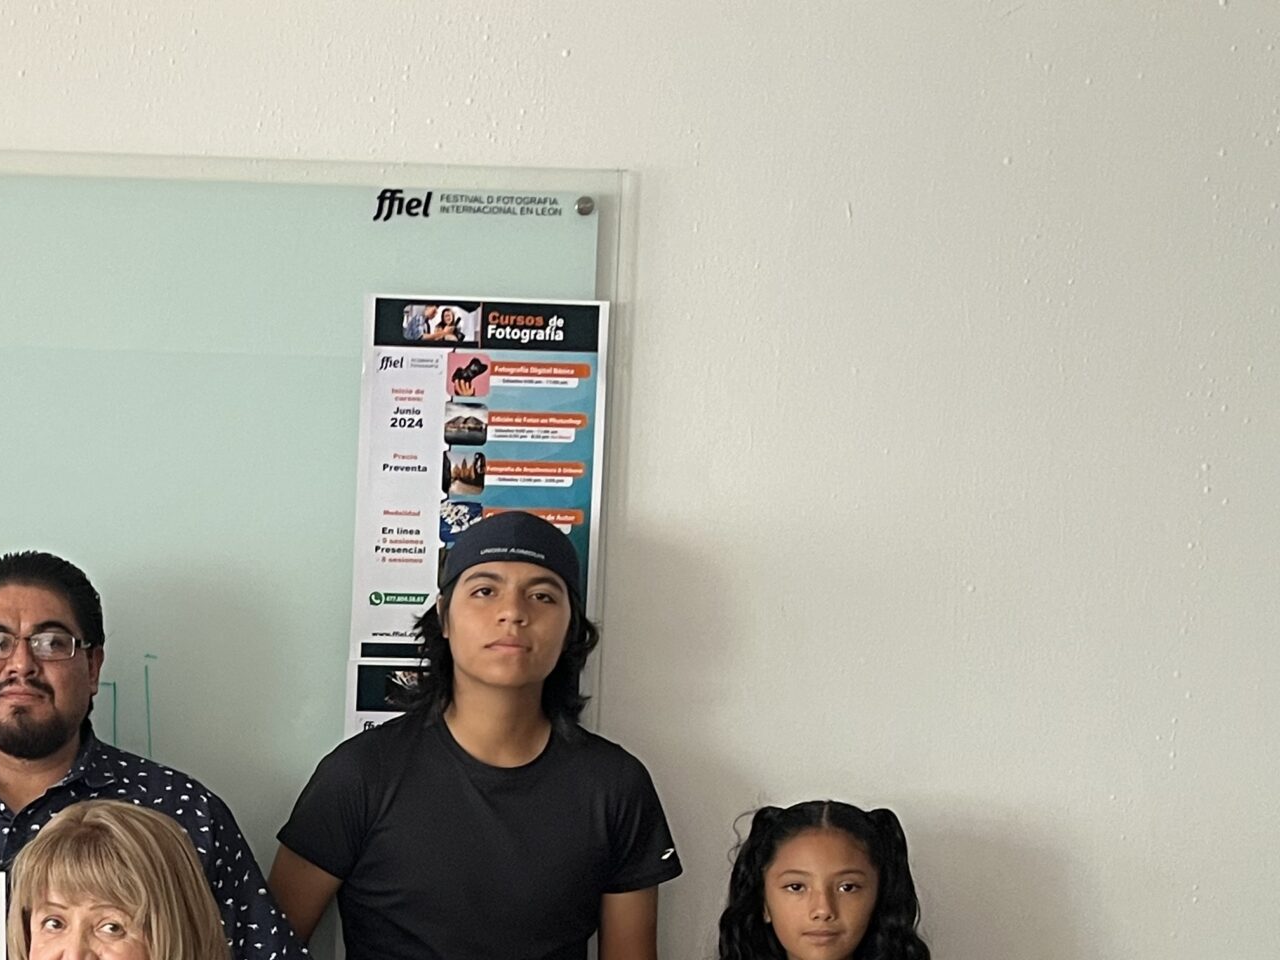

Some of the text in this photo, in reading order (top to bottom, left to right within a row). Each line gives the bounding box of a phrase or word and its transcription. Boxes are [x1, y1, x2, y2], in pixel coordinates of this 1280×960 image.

[440, 194, 484, 204] FESTIVAL
[487, 195, 494, 205] D
[373, 189, 433, 222] ffiel
[440, 205, 518, 216] INTERNACIONAL
[520, 206, 533, 216] EN
[488, 311, 565, 328] Cursos de
[393, 407, 421, 415] Junio
[390, 417, 424, 428] 2024
[382, 463, 428, 472] Preventa
[381, 527, 394, 535] En
[375, 546, 426, 554] Presencial
